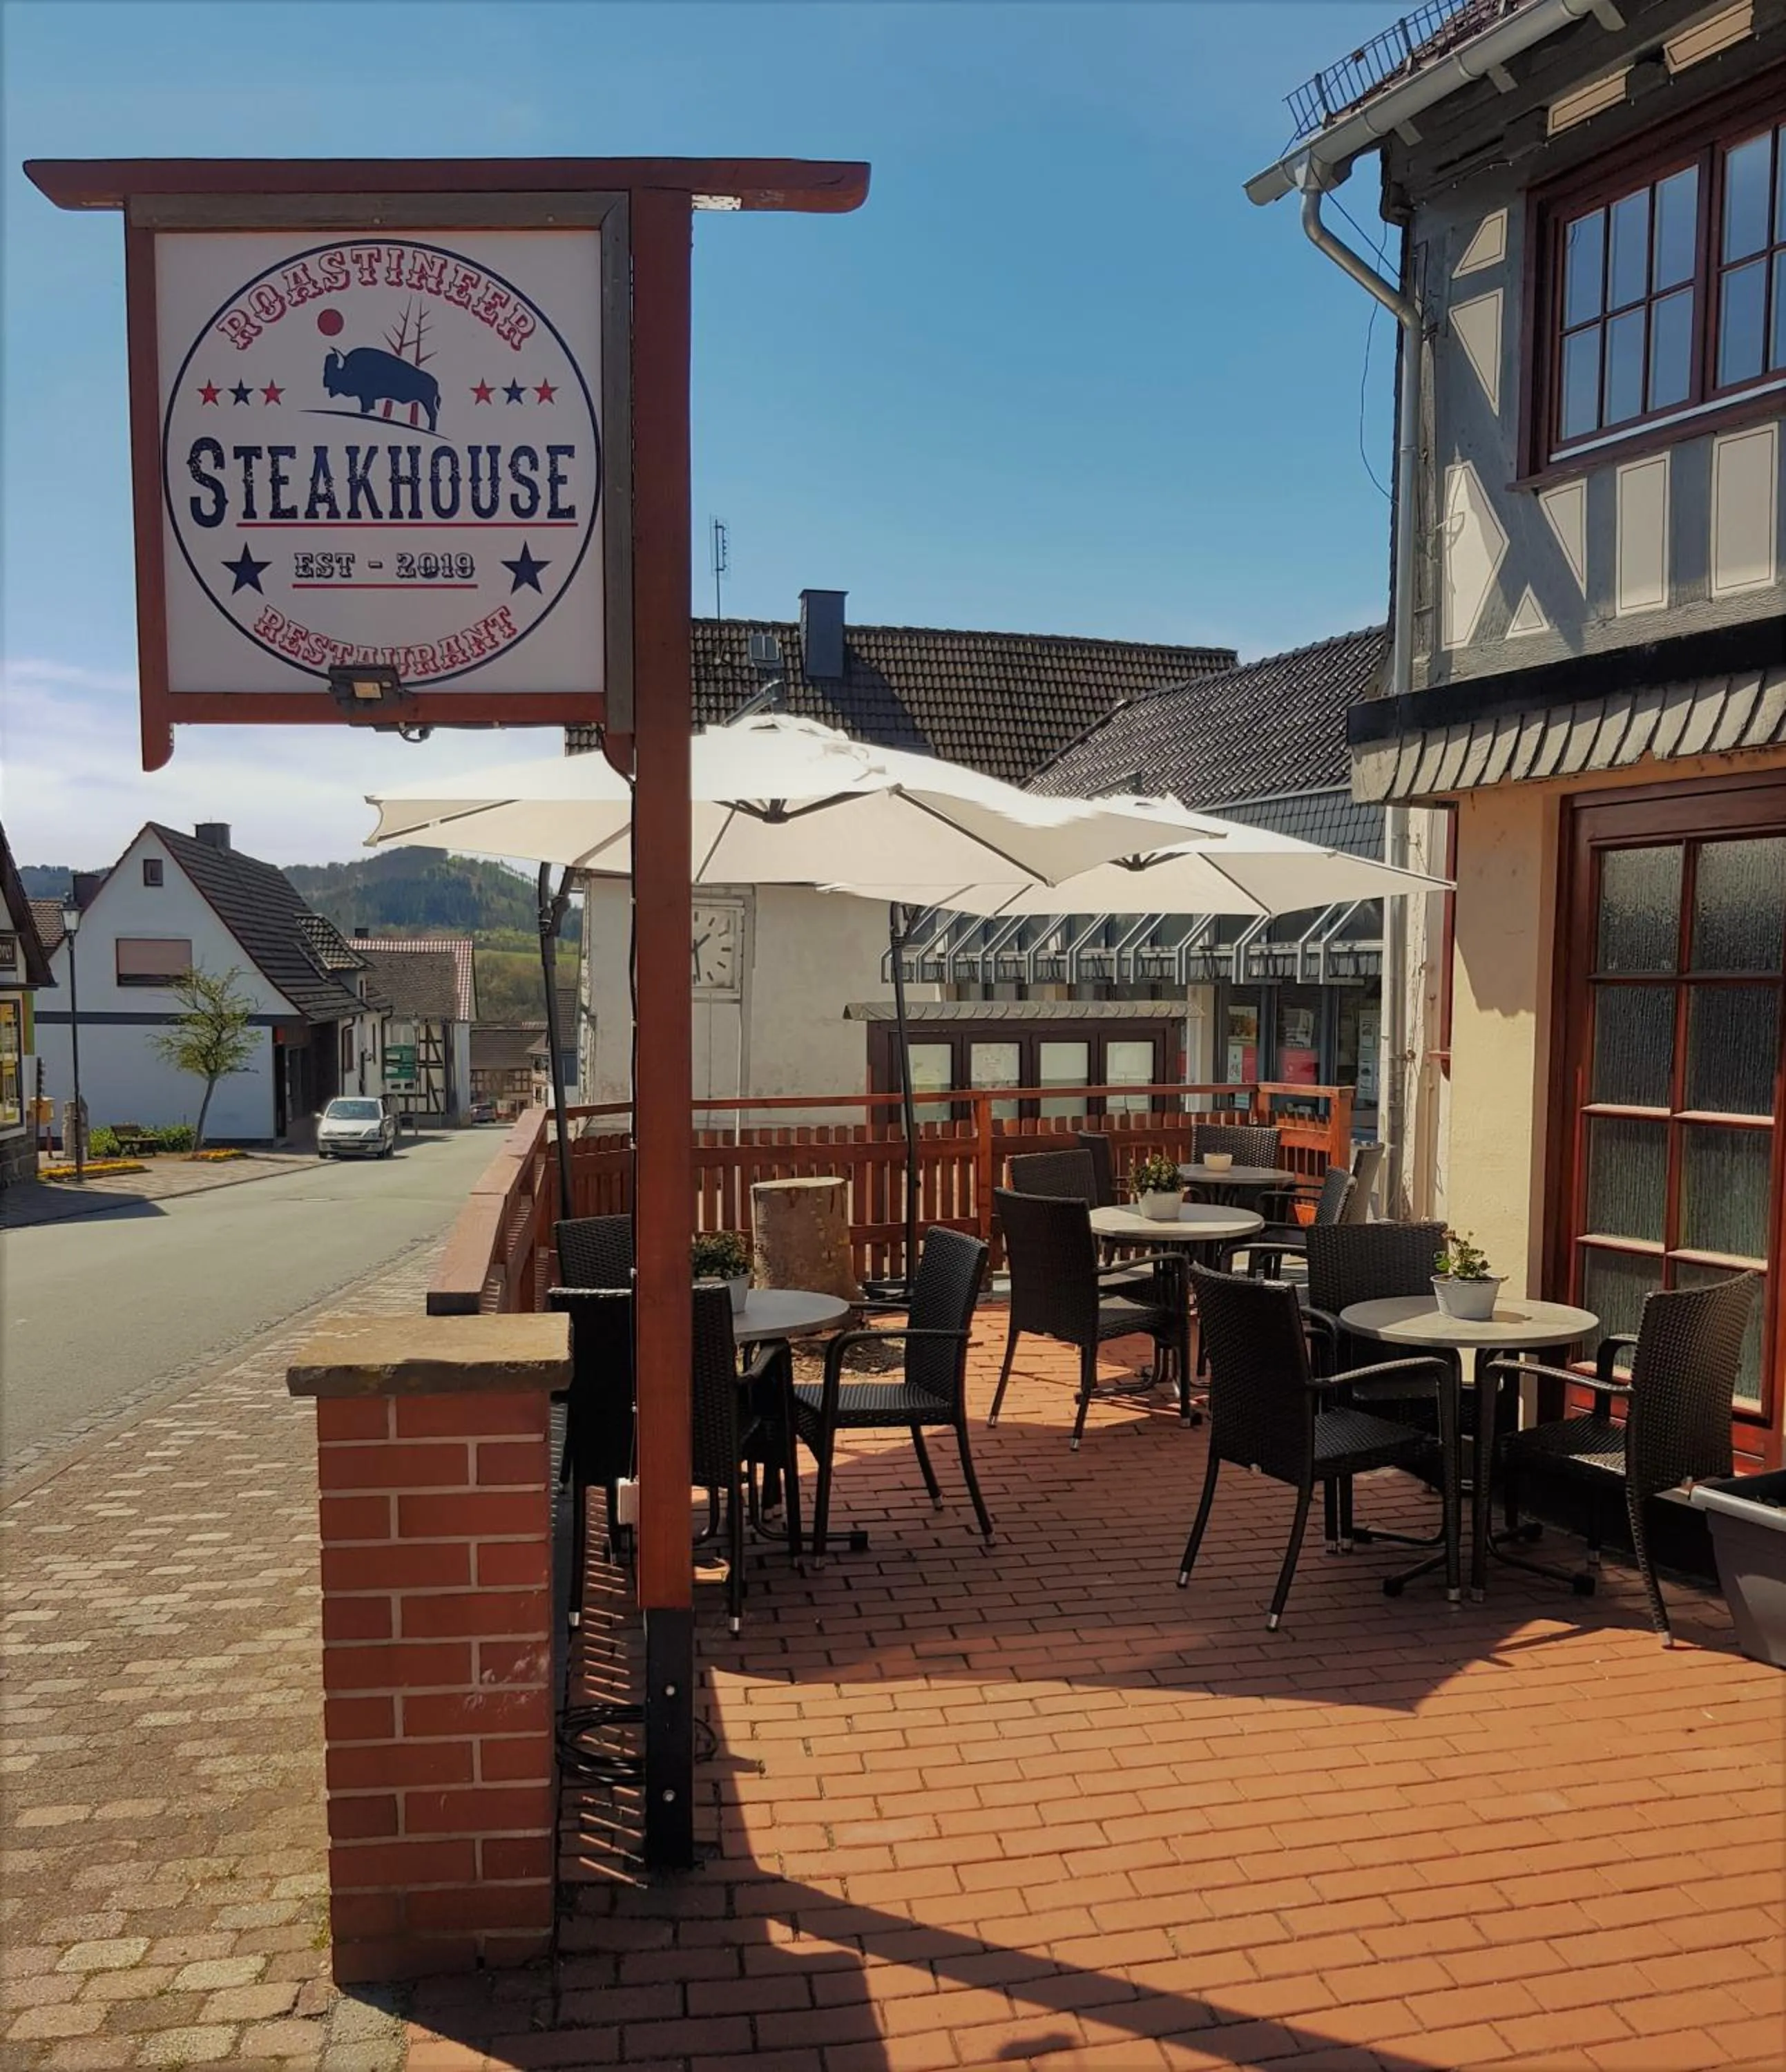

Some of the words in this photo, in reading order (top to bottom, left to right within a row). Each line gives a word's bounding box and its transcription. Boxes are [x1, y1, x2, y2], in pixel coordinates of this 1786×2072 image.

[216, 245, 537, 351] ROASTINEER
[186, 437, 576, 528] STEAKHOUSE
[294, 553, 355, 579] EST
[396, 553, 475, 579] 2019
